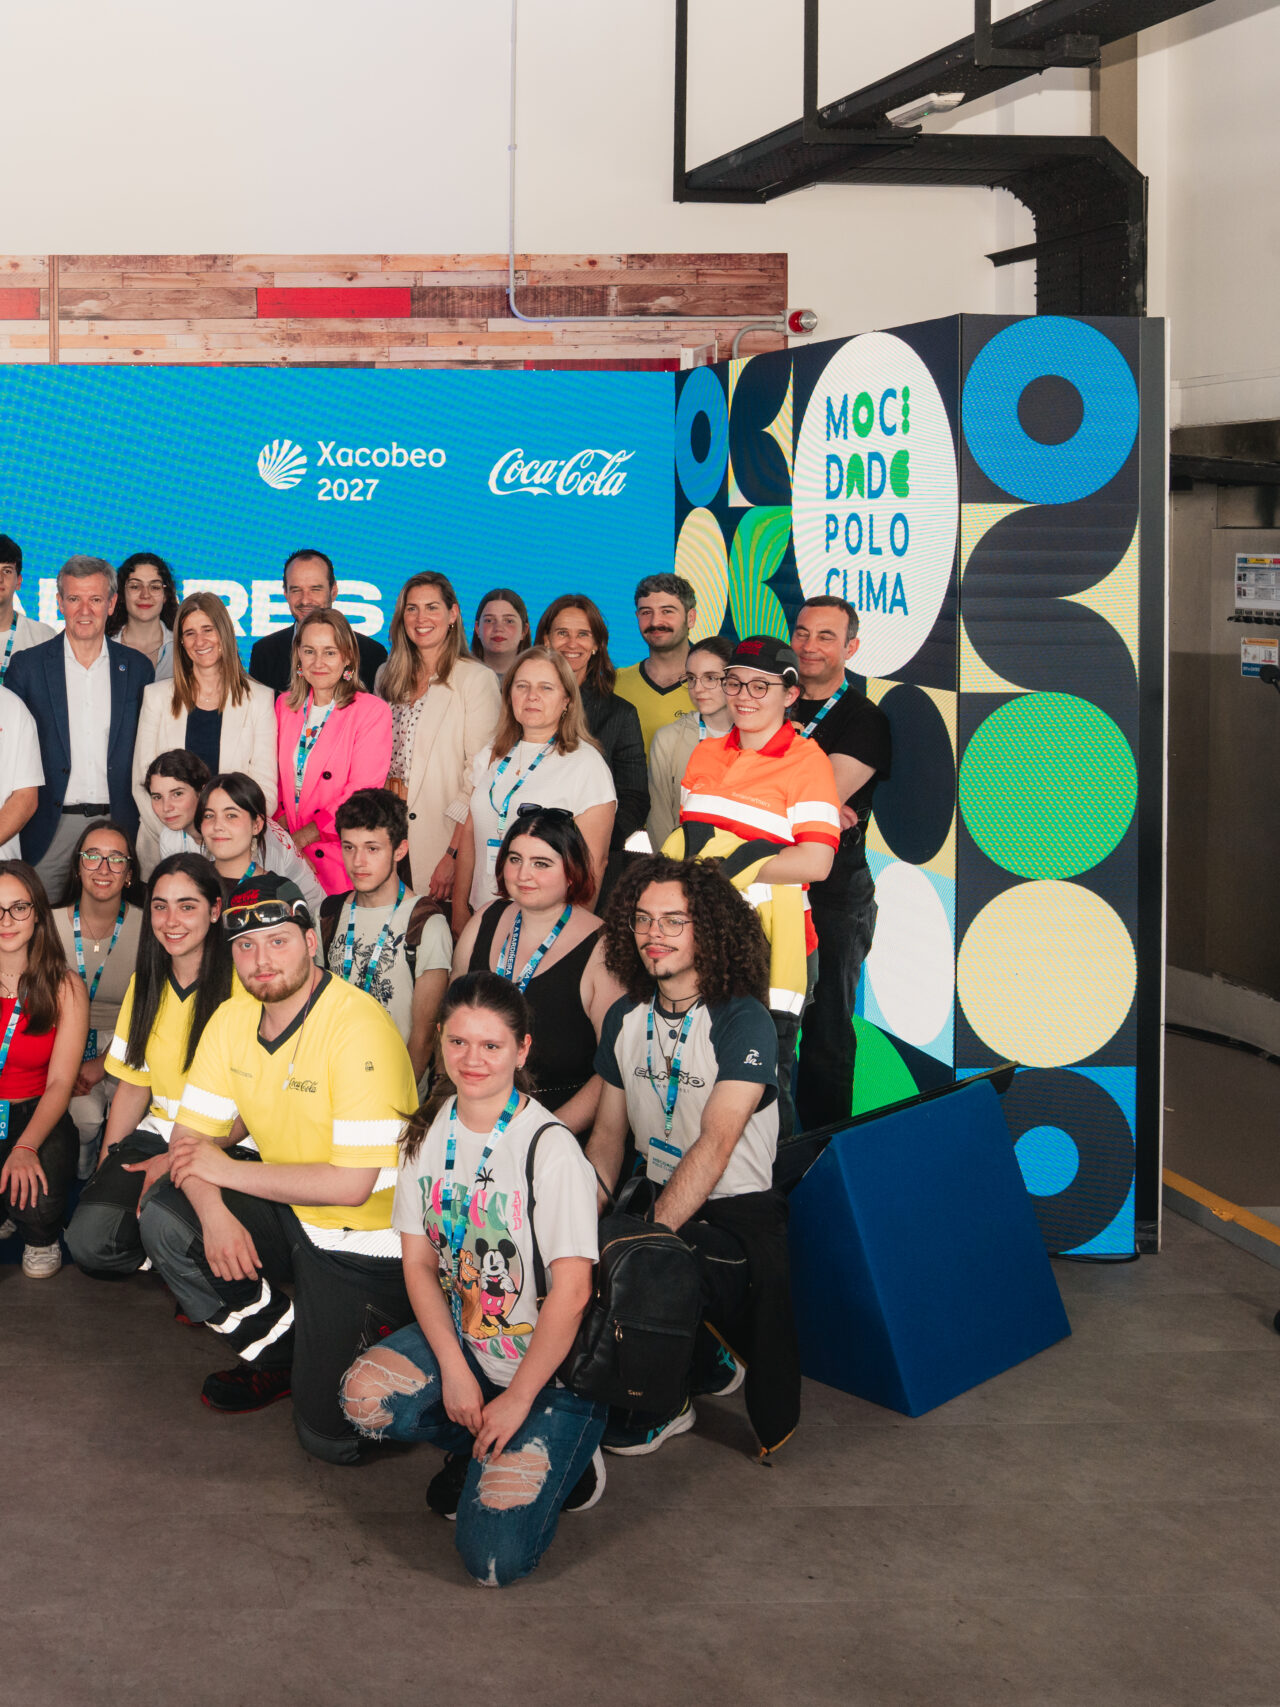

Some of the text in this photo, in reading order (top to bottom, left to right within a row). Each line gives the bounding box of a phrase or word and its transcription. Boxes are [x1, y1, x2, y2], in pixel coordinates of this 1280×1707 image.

[316, 440, 447, 468] Xacobeo
[487, 447, 636, 497] Coca-Cola
[317, 478, 380, 501] 2027
[825, 512, 910, 557] POLO
[825, 567, 909, 616] CLIMA
[511, 1190, 522, 1231] AND
